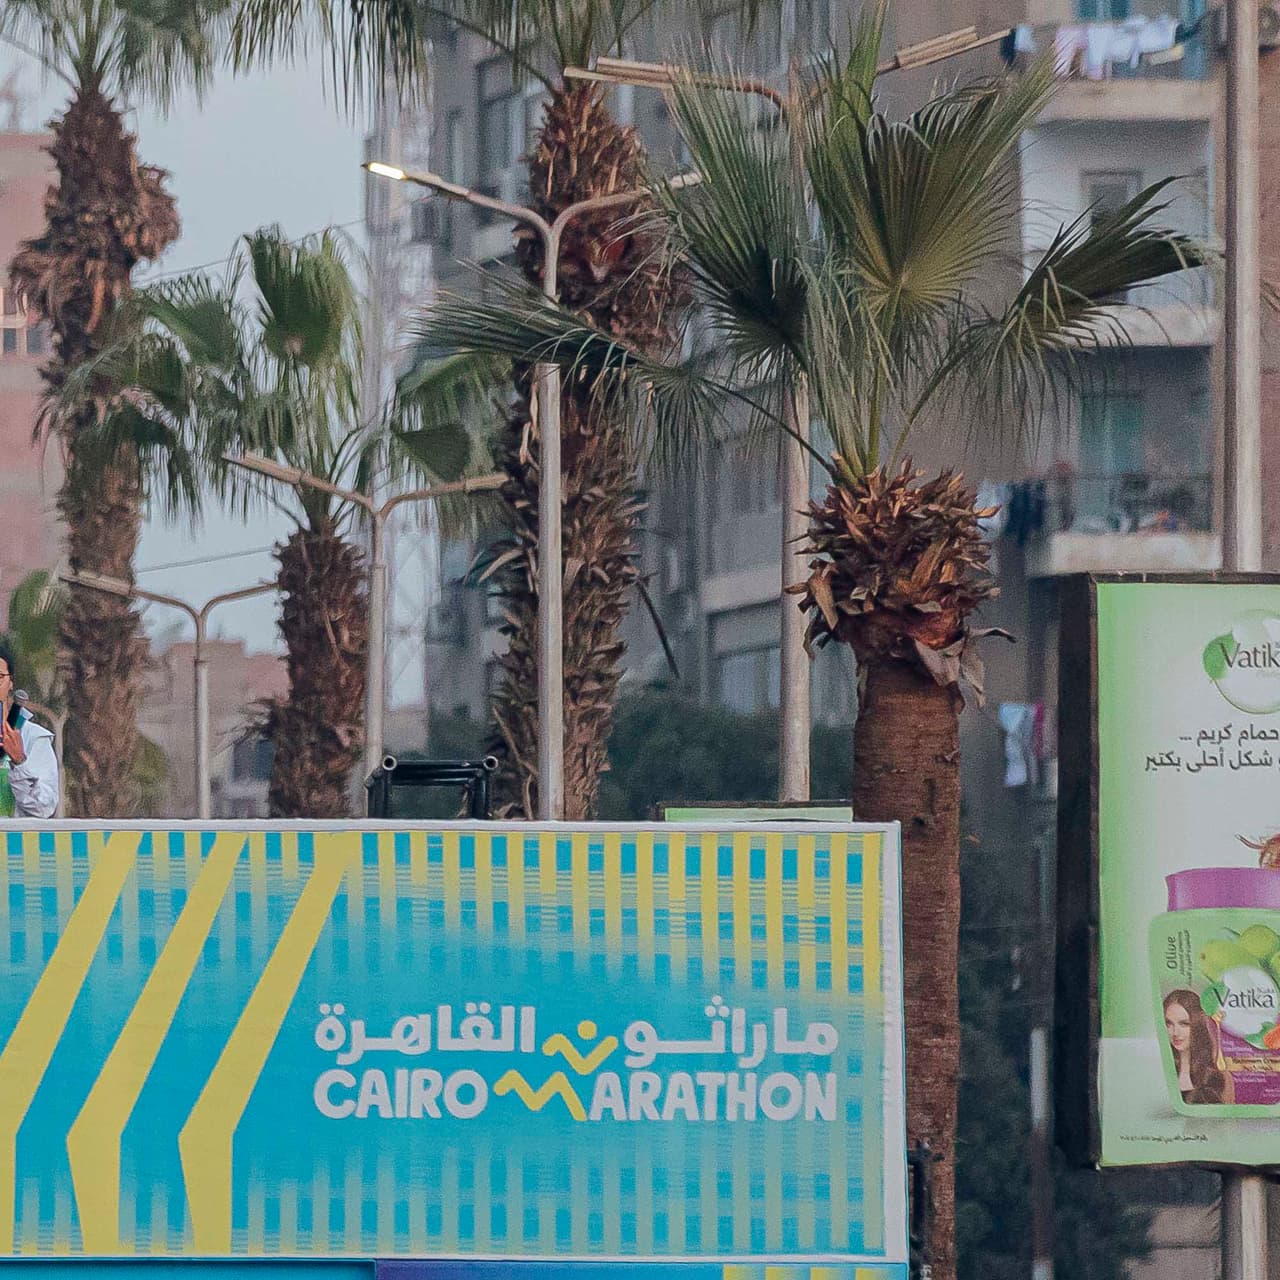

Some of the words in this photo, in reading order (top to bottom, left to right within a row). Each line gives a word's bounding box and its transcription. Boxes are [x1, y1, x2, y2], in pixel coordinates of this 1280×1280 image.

[1218, 642, 1280, 668] Vatik
[1197, 723, 1232, 747] كريم
[1145, 751, 1181, 772] بكتير
[1186, 747, 1224, 772] أحلى
[1229, 750, 1272, 770] شكل
[1213, 986, 1275, 1009] Vatika
[315, 1002, 536, 1065] القاهرة
[313, 1069, 489, 1120] CAIRO
[493, 1069, 839, 1122] MARATHON
